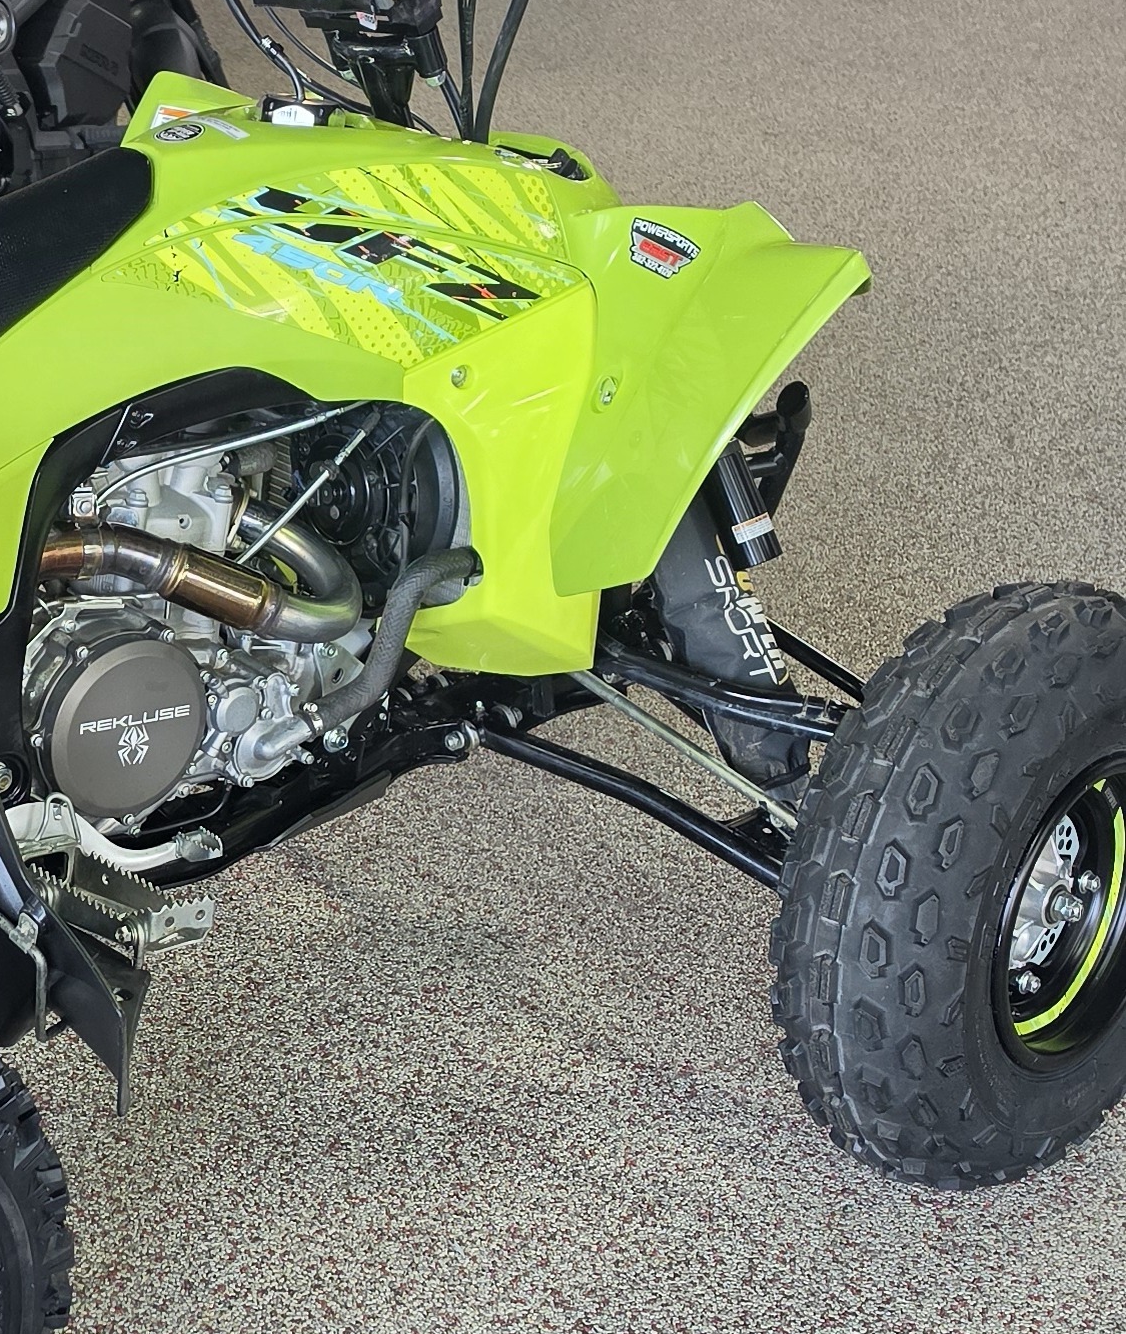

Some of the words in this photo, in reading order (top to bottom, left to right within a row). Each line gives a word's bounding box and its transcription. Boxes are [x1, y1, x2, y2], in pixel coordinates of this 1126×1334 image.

[633, 218, 701, 259] POWERSPORTS
[703, 555, 779, 686] SPORT
[78, 704, 191, 736] REKLUSE
